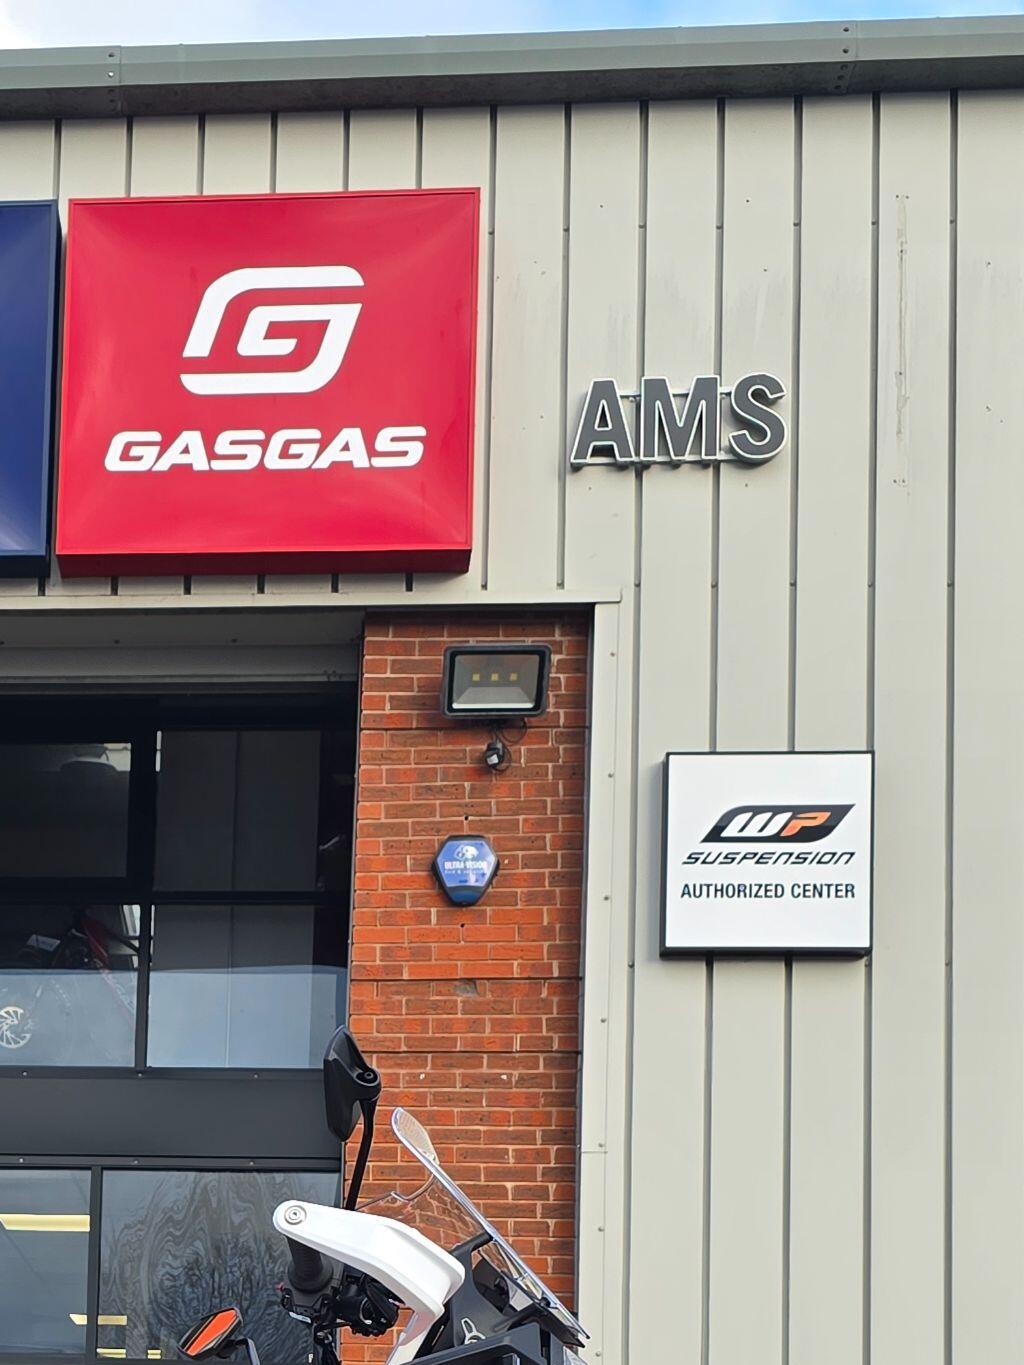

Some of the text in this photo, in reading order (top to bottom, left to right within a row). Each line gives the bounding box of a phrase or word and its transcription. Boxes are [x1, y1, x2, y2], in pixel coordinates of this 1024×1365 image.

[570, 373, 787, 466] AMS
[104, 426, 427, 471] GASGAS
[717, 809, 835, 839] WP
[681, 851, 856, 865] SUSPENSION
[680, 883, 856, 899] AUTHORIZED CENTER
